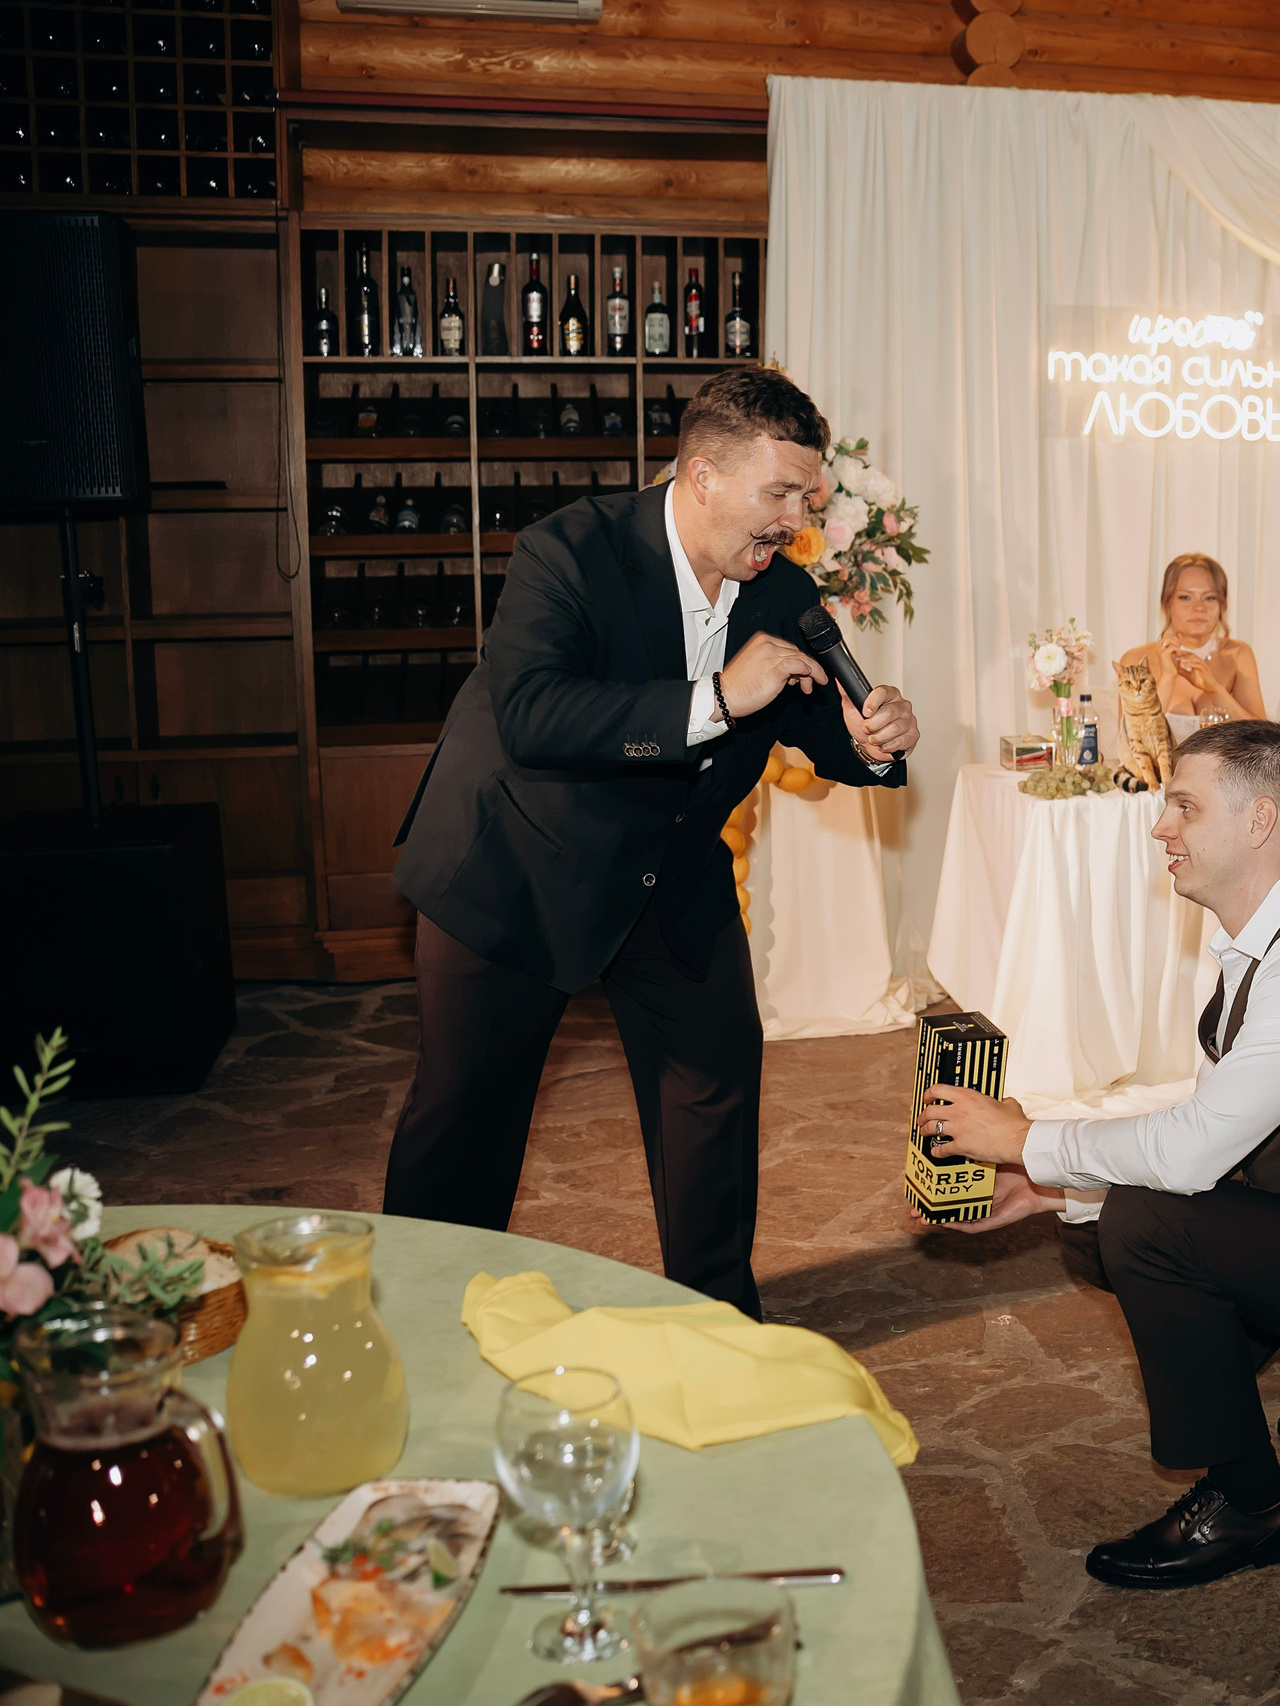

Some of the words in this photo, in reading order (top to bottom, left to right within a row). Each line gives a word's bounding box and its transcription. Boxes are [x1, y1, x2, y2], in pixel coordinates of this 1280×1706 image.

[1047, 350, 1172, 385] такая
[911, 1150, 986, 1186] TORRES
[914, 1170, 974, 1196] BRANDY
